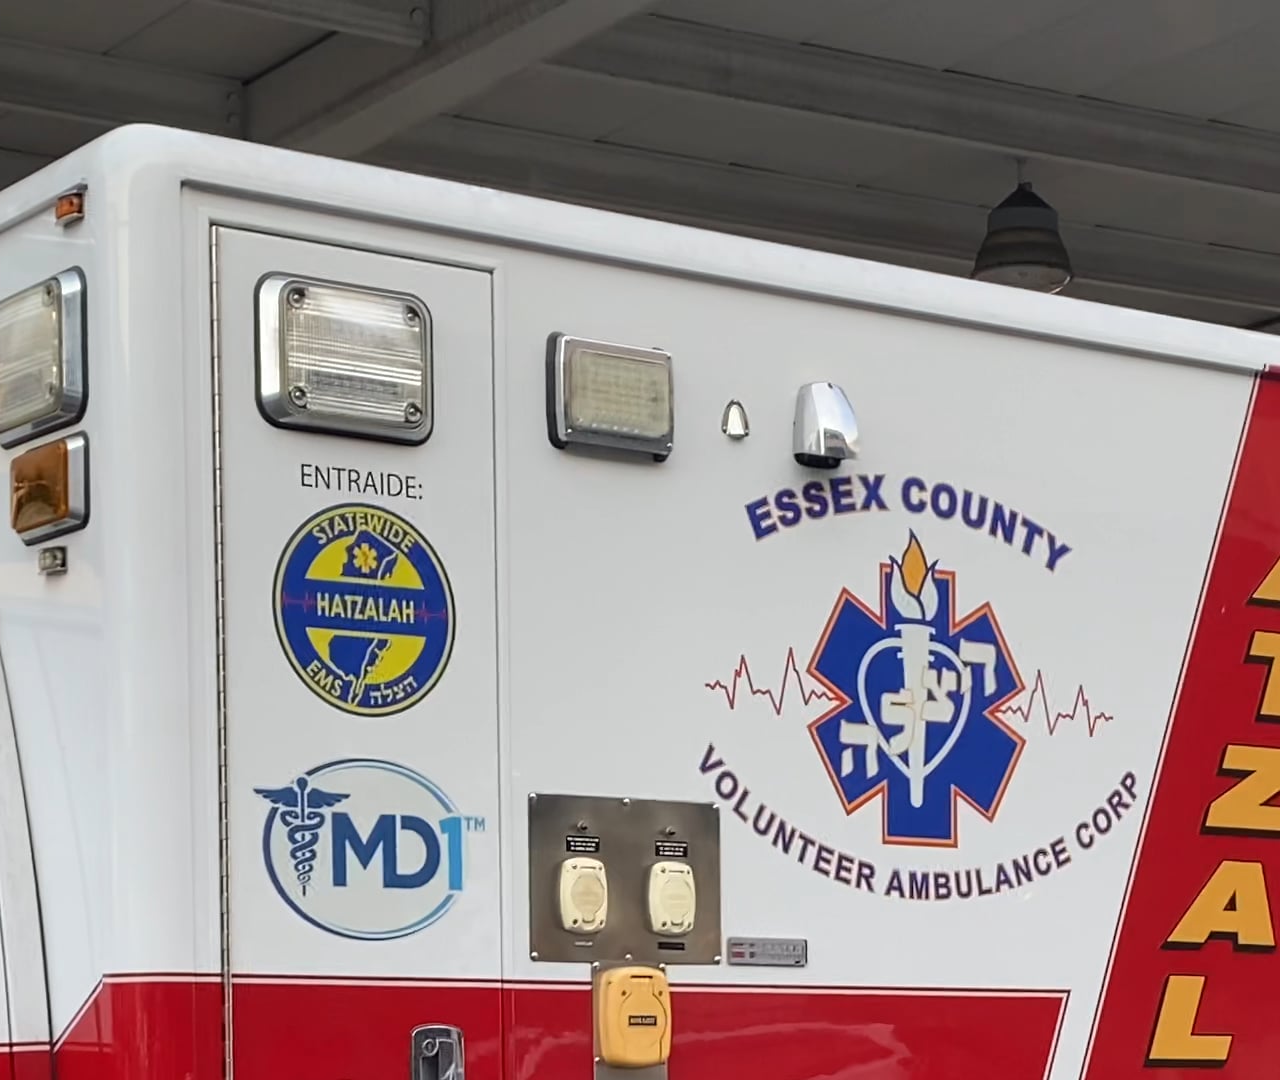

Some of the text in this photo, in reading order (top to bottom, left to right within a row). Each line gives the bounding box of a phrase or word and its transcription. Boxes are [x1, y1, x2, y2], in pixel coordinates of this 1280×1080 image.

[300, 463, 423, 500] ENTRAIDE:
[311, 511, 416, 554] STATEWIDE
[745, 474, 1072, 573] ESSEX COUNTY
[316, 592, 415, 624] HATZALAH
[305, 659, 345, 698] EMS
[698, 743, 1139, 901] VOLUNTEER AMBULANCE CORP
